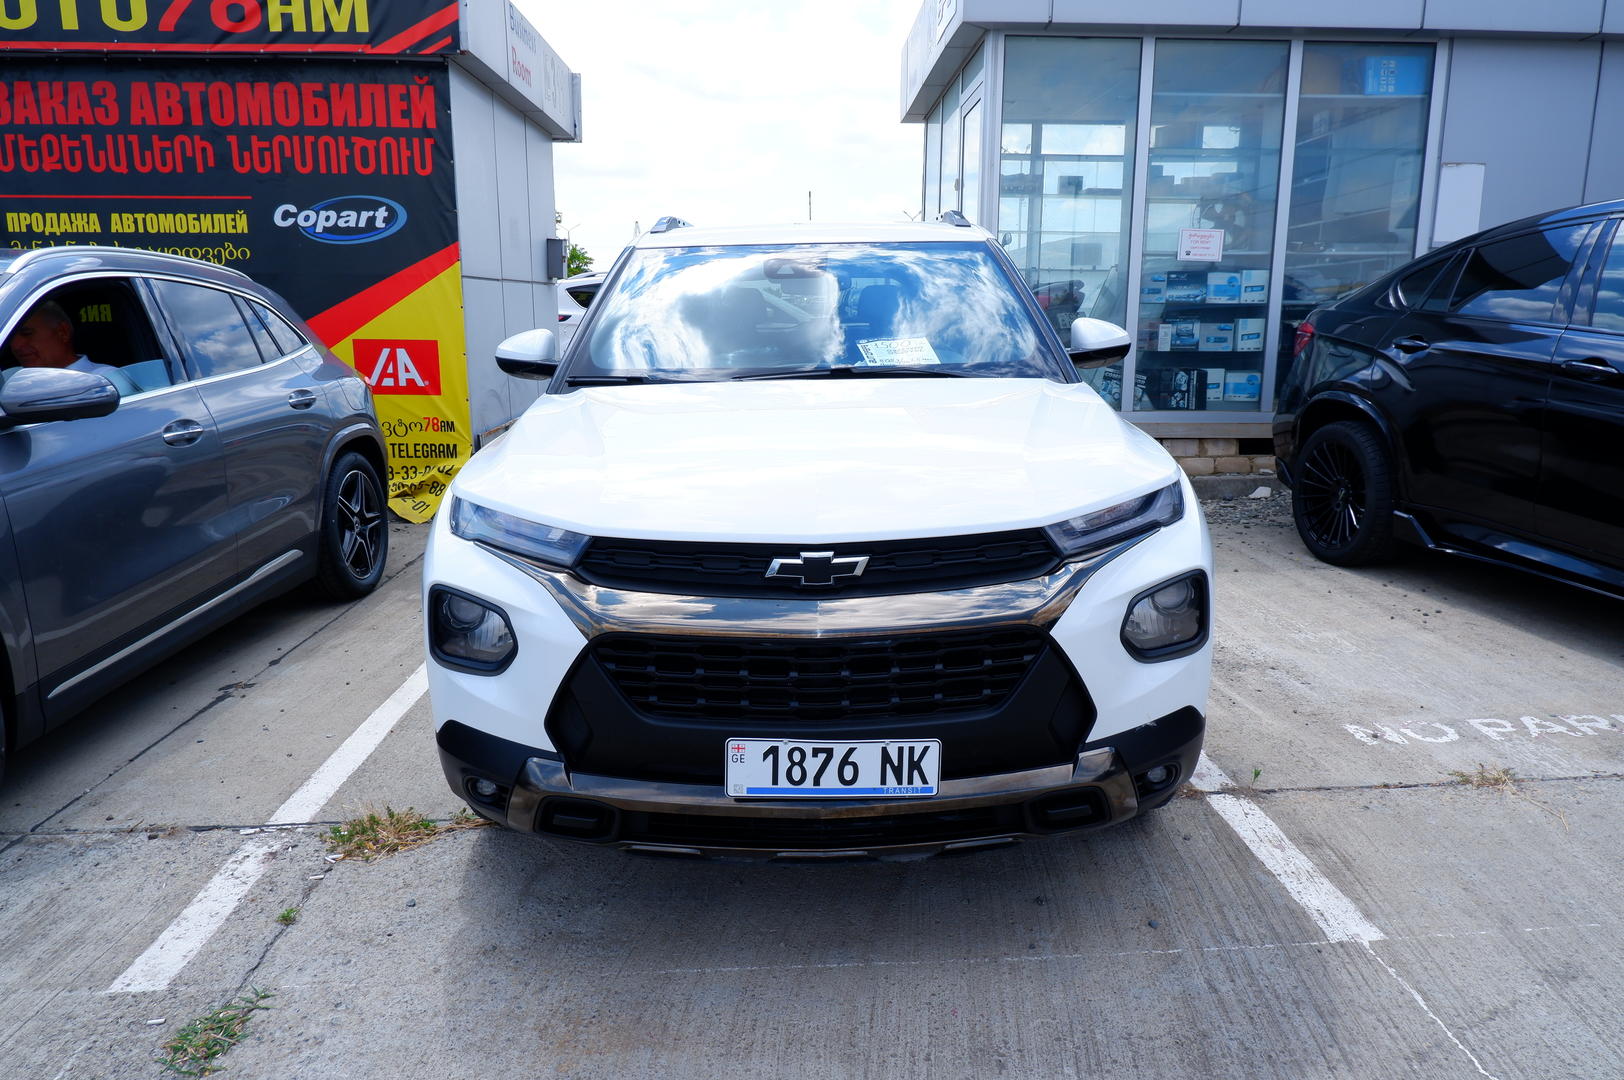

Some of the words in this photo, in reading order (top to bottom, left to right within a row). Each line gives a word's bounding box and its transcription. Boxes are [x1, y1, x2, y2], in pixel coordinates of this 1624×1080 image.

[130, 76, 437, 129] АВТОМОБИЛЕЙ
[6, 212, 101, 236] ПРОДАЖА
[110, 209, 249, 234] АВТОМОБИЛЕЙ
[273, 203, 389, 233] Copart
[390, 443, 458, 459] TELEGRAM
[1341, 719, 1460, 745] NO
[731, 753, 745, 764] GE
[762, 745, 859, 787] 1876
[880, 745, 931, 786] NK
[883, 786, 923, 795] TRANSIT
